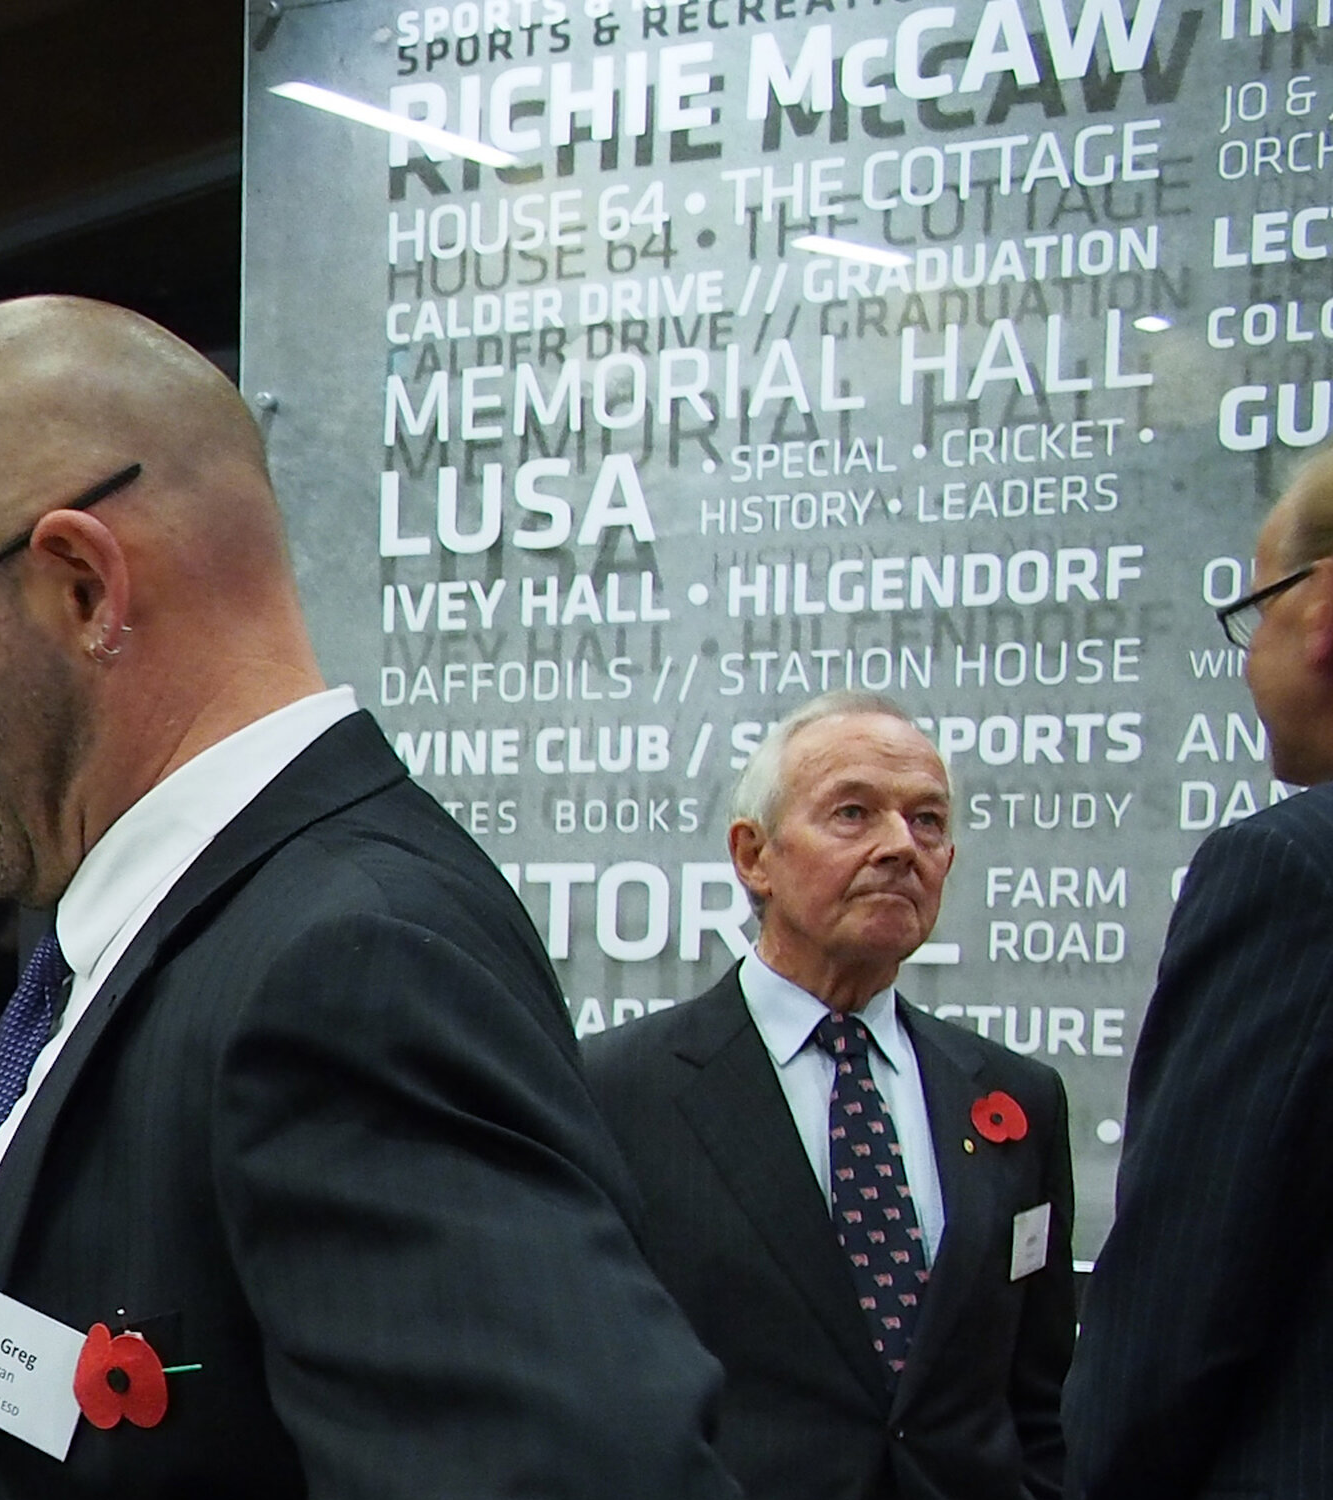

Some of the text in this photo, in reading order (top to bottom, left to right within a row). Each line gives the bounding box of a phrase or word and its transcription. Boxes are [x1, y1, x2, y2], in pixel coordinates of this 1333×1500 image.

[388, 0, 1162, 168] RICHIE McCAW
[1219, 75, 1318, 134] JO &
[387, 119, 1162, 266] HOUSE 64 THE COTTAGE
[1213, 207, 1333, 269] LEC
[386, 285, 565, 346] CALDER
[579, 270, 724, 327] DRIVE
[802, 226, 1159, 303] GRADUATION
[383, 308, 1154, 447] MEMORIAL HALL
[1218, 381, 1332, 451] GU
[379, 417, 1125, 558] LUSA SPECIAL CRICKET
[699, 473, 1119, 536] HISTORY LEADERS
[382, 545, 1144, 634] IVEY HALL HILGENDORF
[380, 656, 633, 708] DAFFODILS
[719, 645, 932, 697] STATION
[955, 637, 1142, 688] HOUSE
[535, 724, 671, 775] CLUB
[910, 712, 1143, 766] PORTS
[554, 798, 700, 835] BOOKS
[969, 792, 1133, 830] STUDY
[985, 866, 1126, 910] FARM
[988, 920, 1126, 964] ROAD
[0, 1337, 38, 1372] Greg
[0, 1399, 20, 1417] ESD
